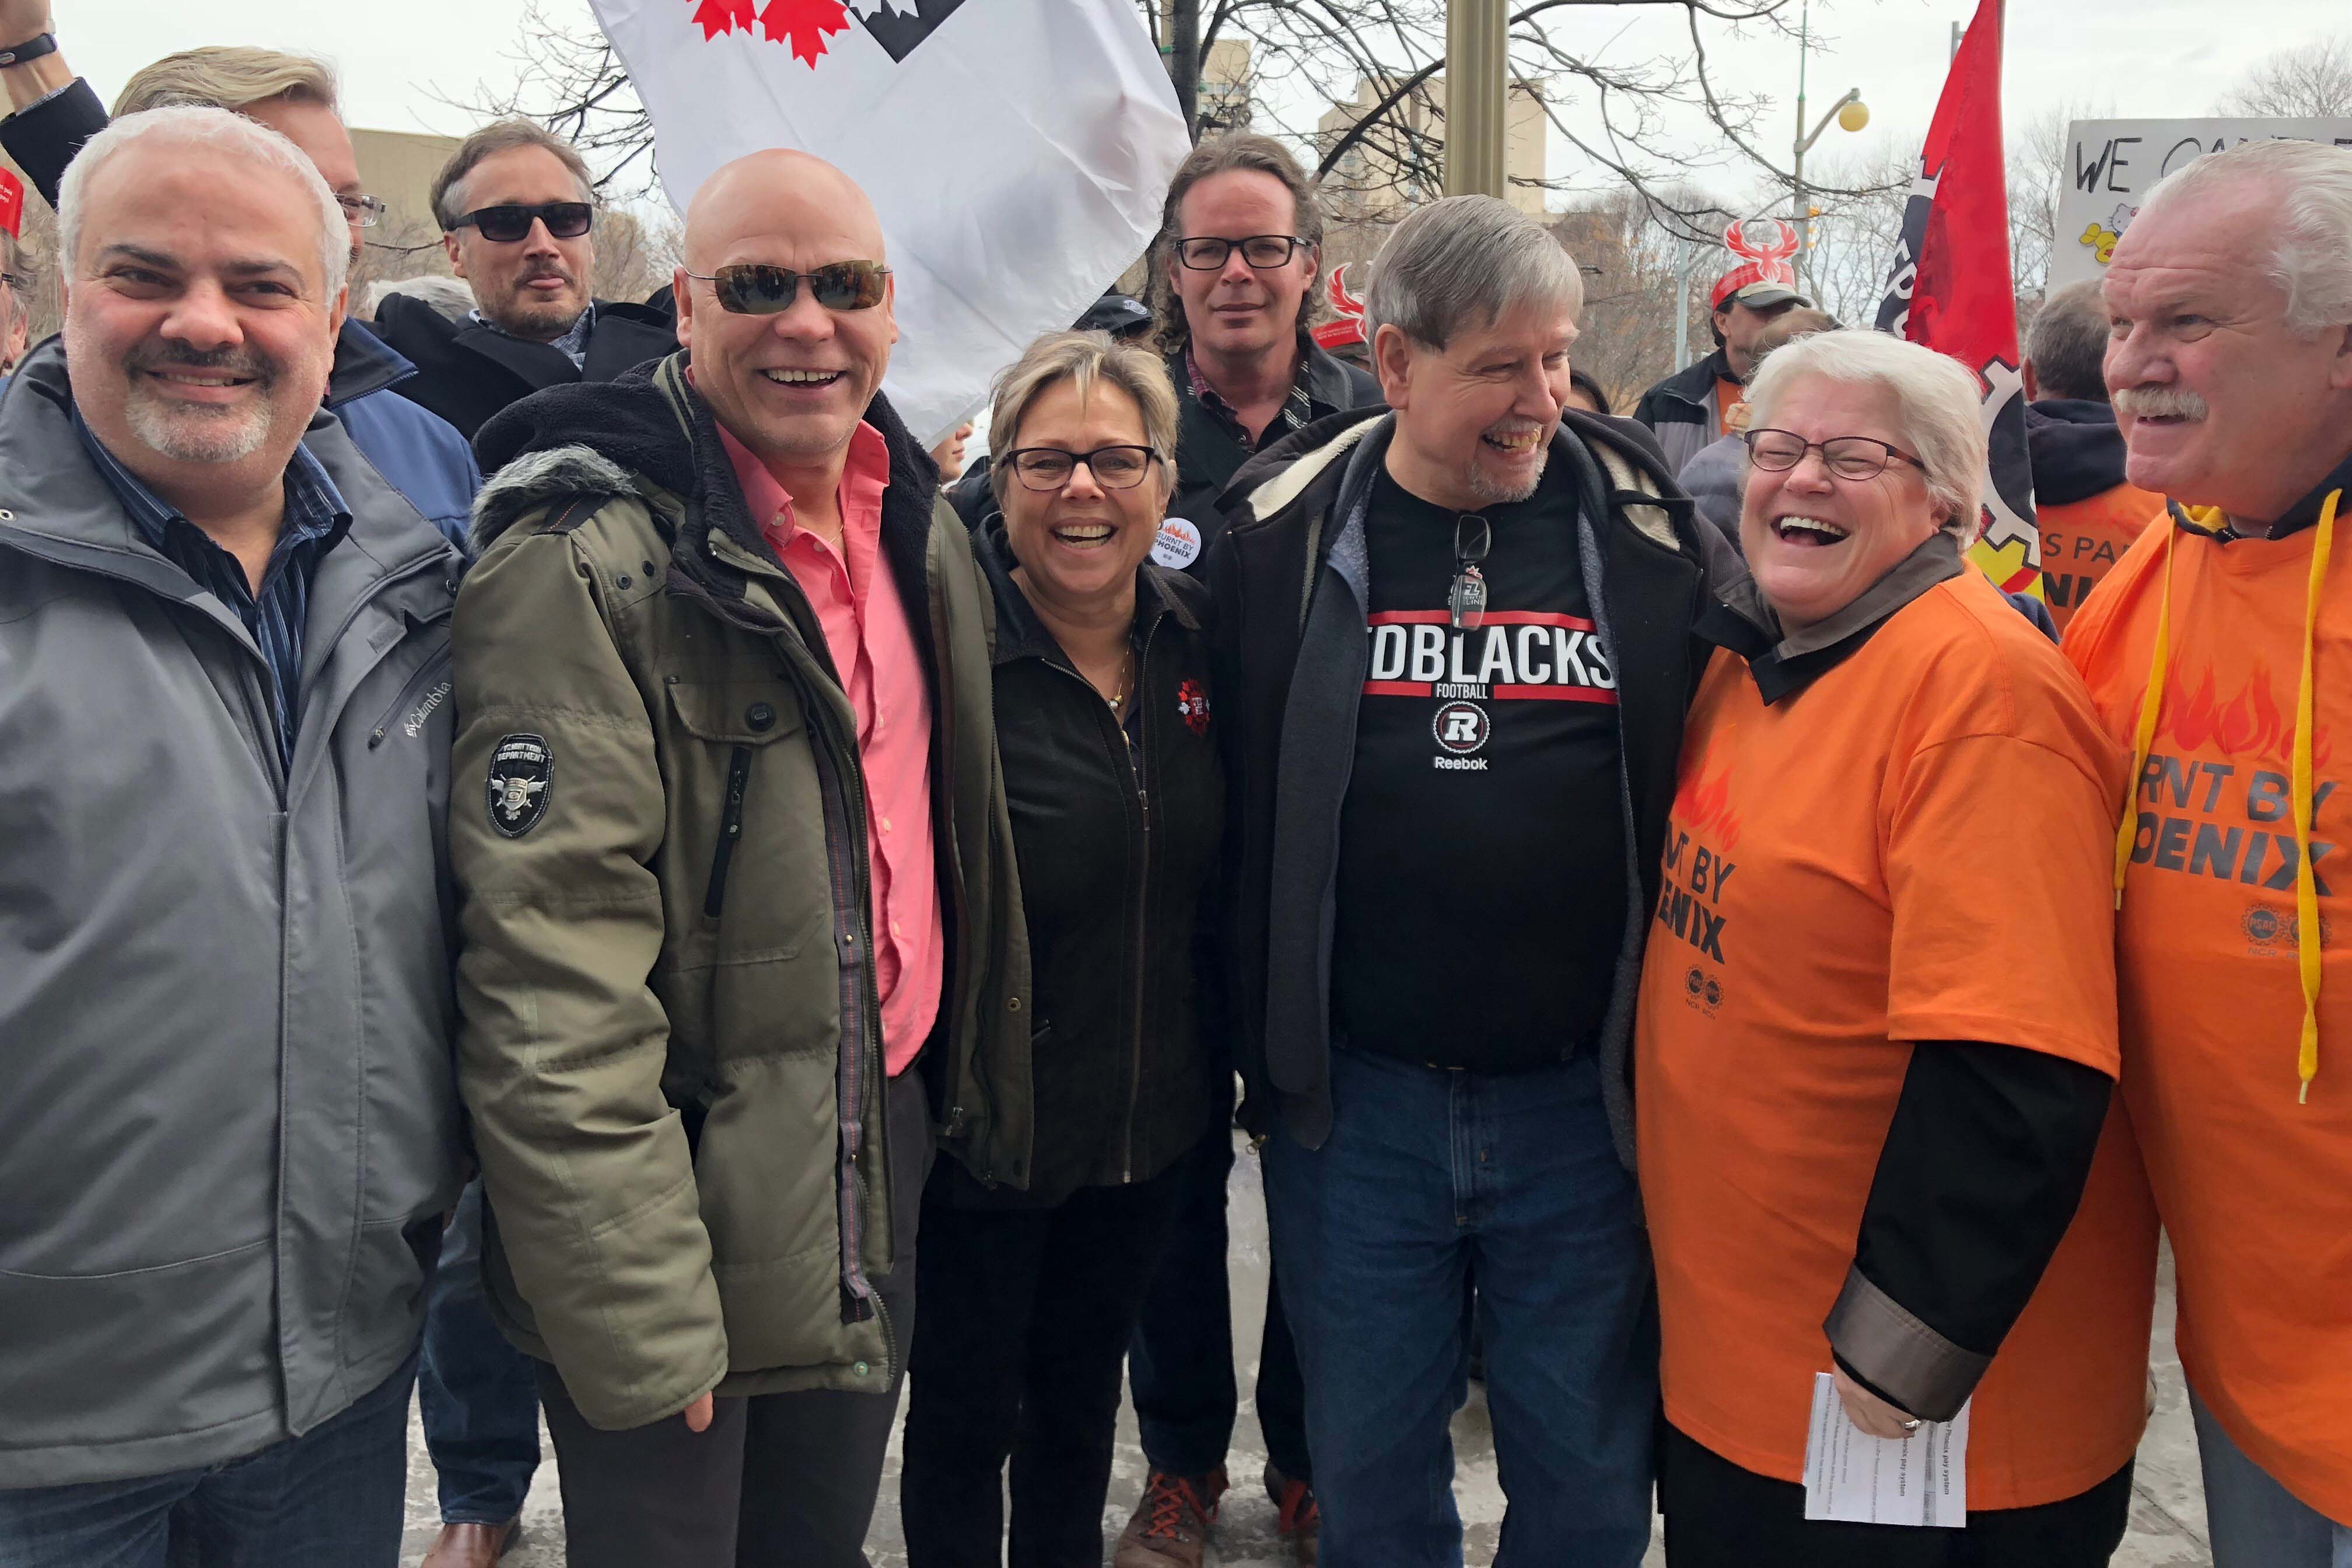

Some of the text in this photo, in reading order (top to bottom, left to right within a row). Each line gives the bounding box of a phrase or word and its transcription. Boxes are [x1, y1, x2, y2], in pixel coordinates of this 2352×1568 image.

[2076, 137, 2143, 194] WE
[1183, 542, 1195, 552] BY
[1367, 625, 1616, 689] DBLACKS
[410, 681, 452, 729] Columbia
[1436, 683, 1488, 699] FOOTBALL
[498, 751, 546, 763] DEPARTMENT
[1434, 756, 1488, 770] Reebok
[2132, 751, 2234, 813] RNT
[1692, 845, 1737, 904] BY
[2130, 812, 2336, 897] OENIX
[1658, 877, 1727, 965] ENIX
[1942, 1455, 1950, 1468] pay
[1943, 1469, 1951, 1495] system
